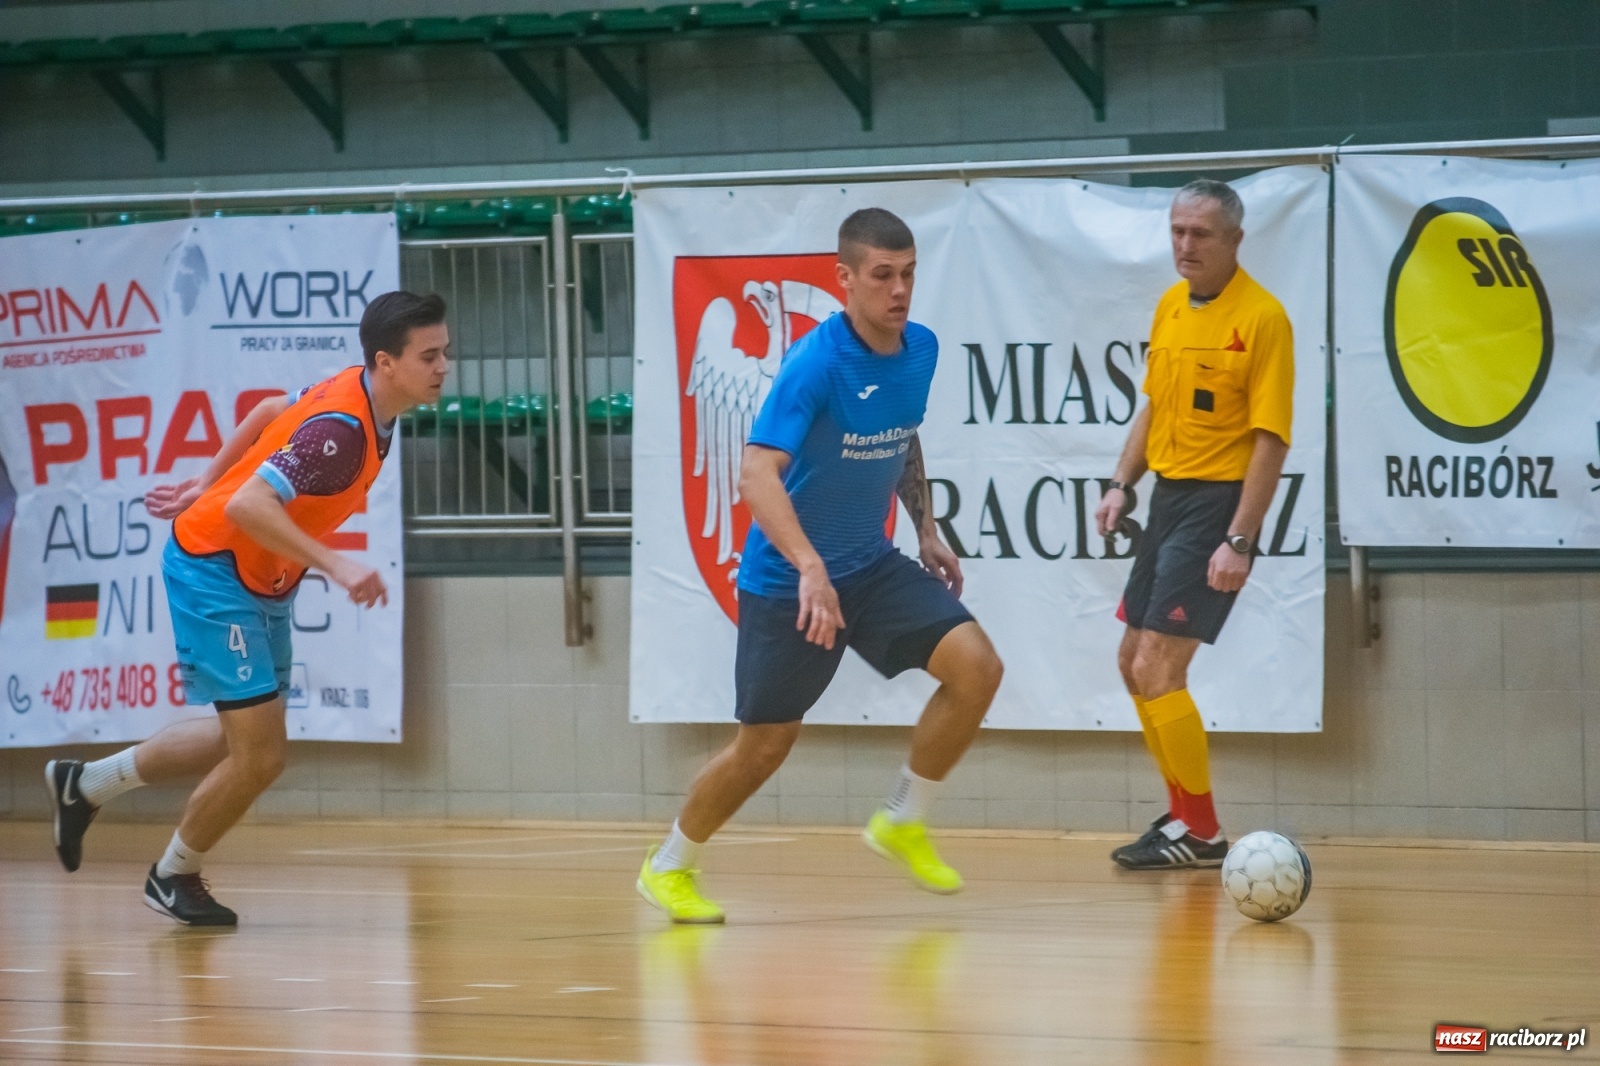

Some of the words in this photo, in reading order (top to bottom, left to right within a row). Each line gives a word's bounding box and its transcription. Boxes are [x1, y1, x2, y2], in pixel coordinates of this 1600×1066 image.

[1458, 236, 1532, 288] SIR
[0, 279, 161, 337] RIMA
[219, 269, 374, 319] WORK
[240, 337, 277, 351] PRACY
[962, 340, 1150, 425] MIAS
[841, 448, 897, 460] Metallbau
[842, 425, 917, 446] Marek&Dan
[1385, 445, 1558, 499] RACIBÓRZ
[43, 497, 151, 563] AUS
[227, 623, 248, 659] 4
[41, 670, 75, 713] +48
[79, 666, 112, 712] 735
[117, 663, 157, 709] 408
